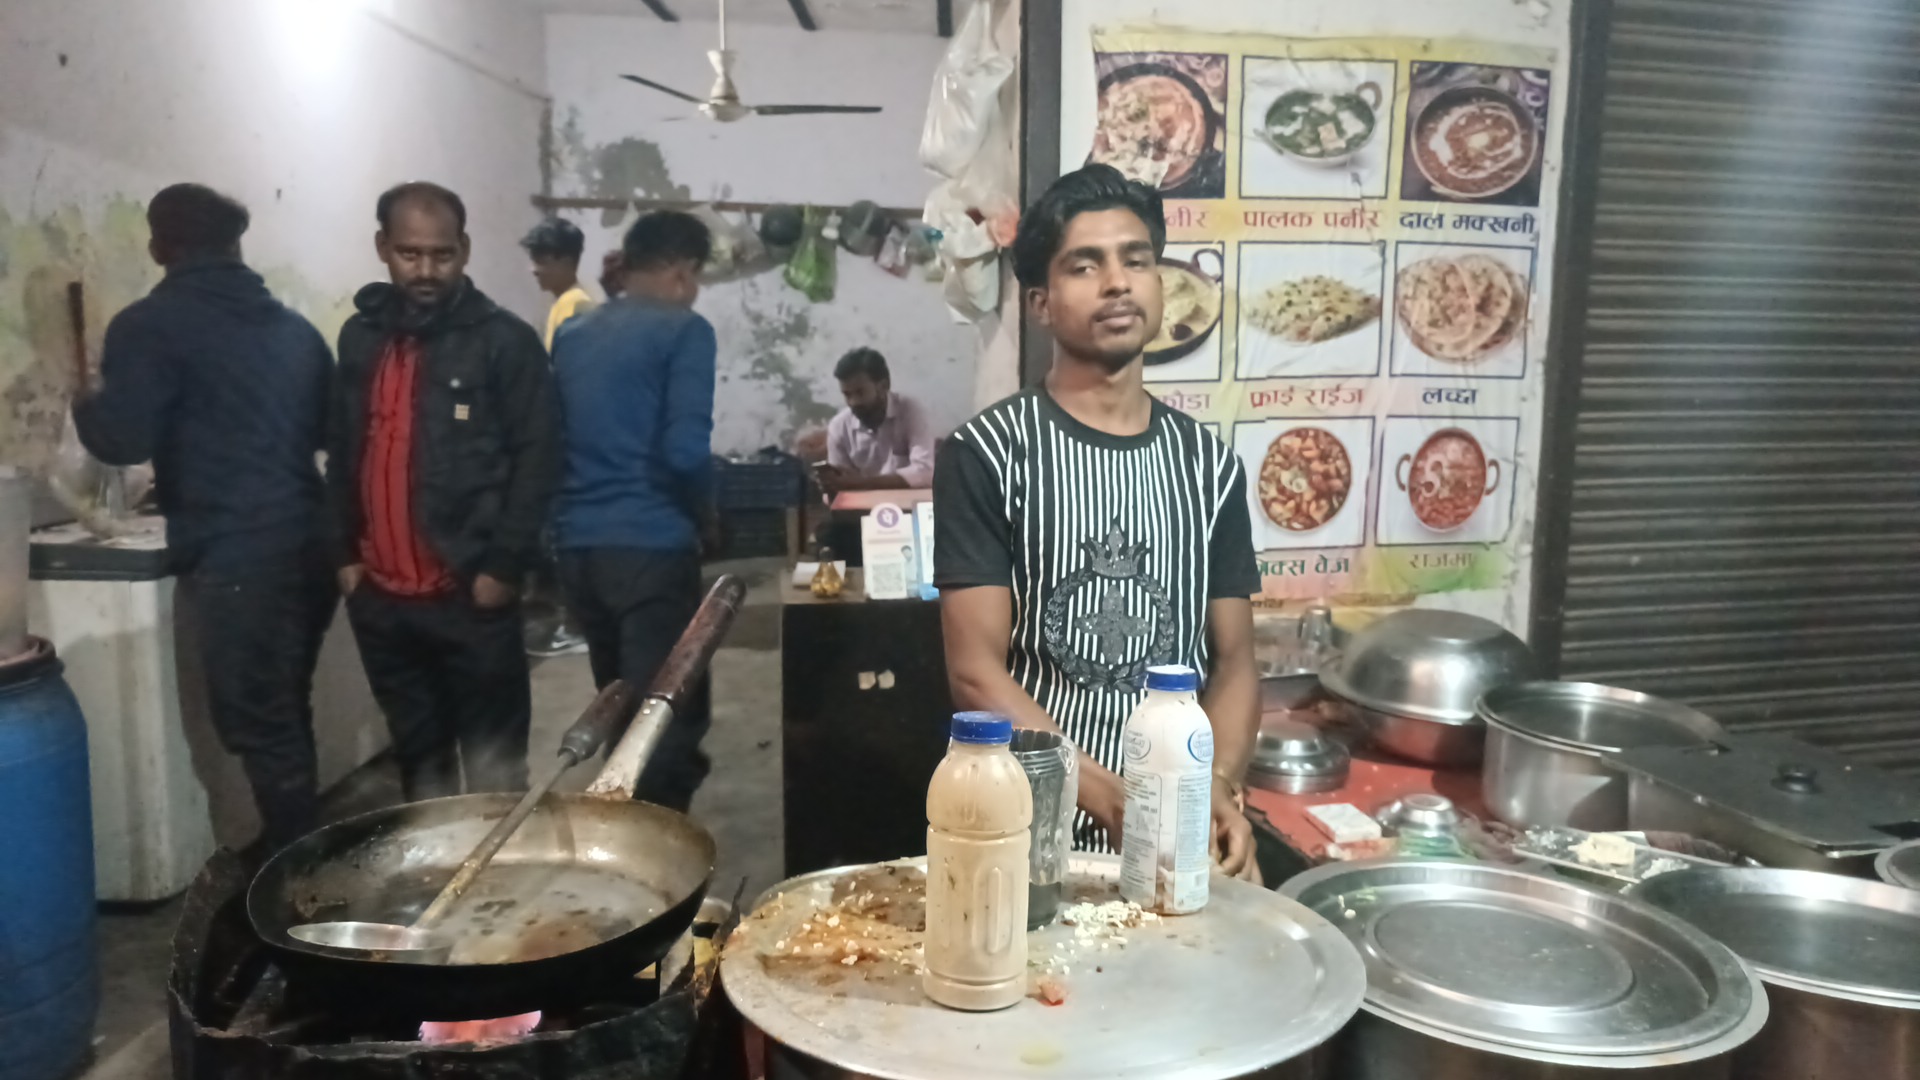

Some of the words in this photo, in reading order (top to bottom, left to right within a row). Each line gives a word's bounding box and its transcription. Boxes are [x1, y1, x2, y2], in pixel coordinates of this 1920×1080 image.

[1243, 210, 1313, 229] पालक
[1322, 205, 1382, 229] पनीर
[1399, 211, 1446, 230] दाल
[1452, 212, 1536, 235] मक्खनी
[1303, 384, 1365, 407] राईज
[1314, 553, 1350, 574] वेज
[1408, 552, 1473, 570] राजमा
